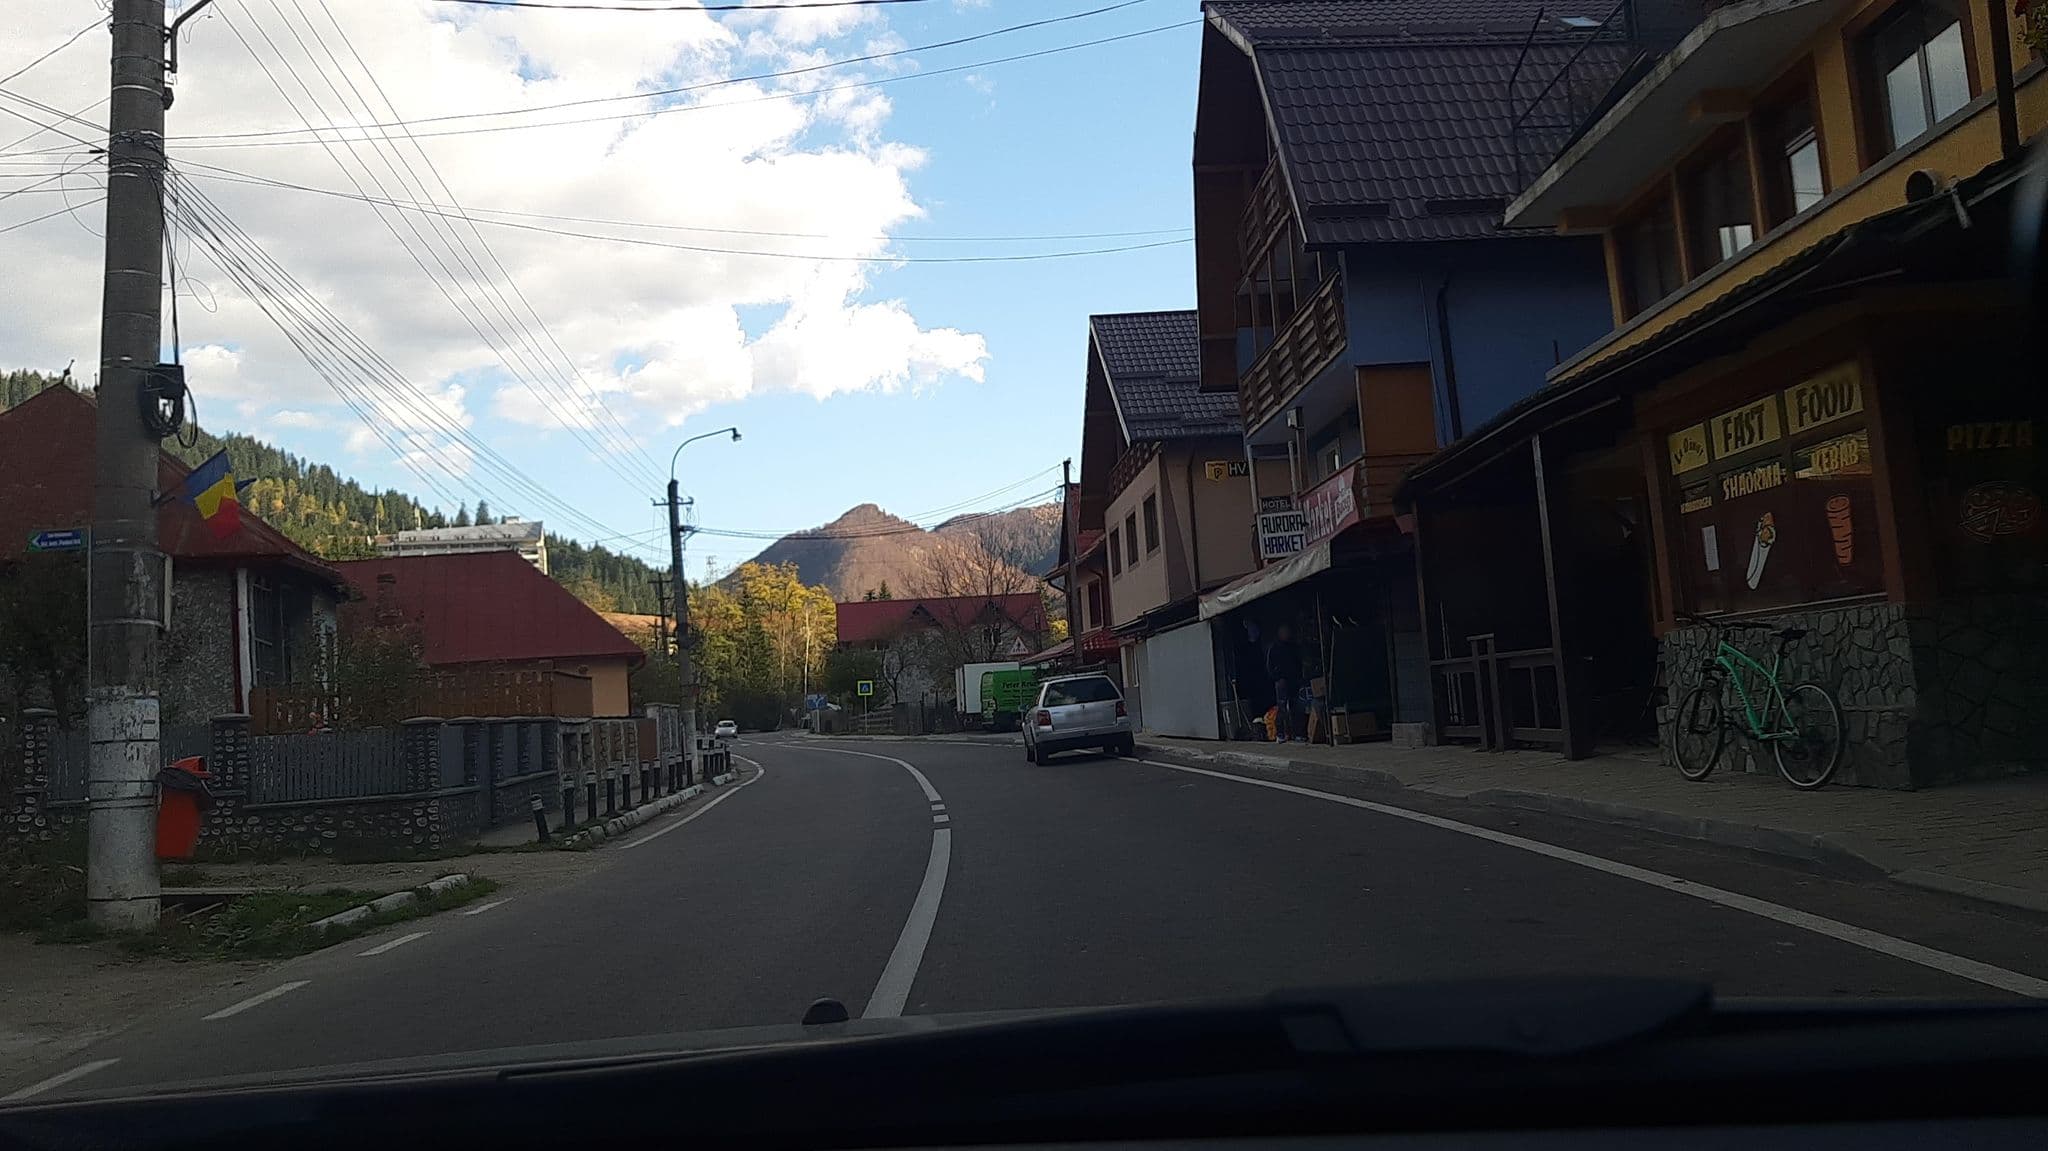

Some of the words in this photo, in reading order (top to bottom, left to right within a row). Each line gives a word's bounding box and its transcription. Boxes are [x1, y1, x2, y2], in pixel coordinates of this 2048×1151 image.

[1722, 403, 1764, 452] FAST
[1796, 379, 1853, 428] FOOD
[1946, 421, 2032, 450] PIZZA
[1810, 439, 1859, 474] KEBAB
[1262, 498, 1291, 510] HOTEL
[1261, 513, 1304, 534] AURORA
